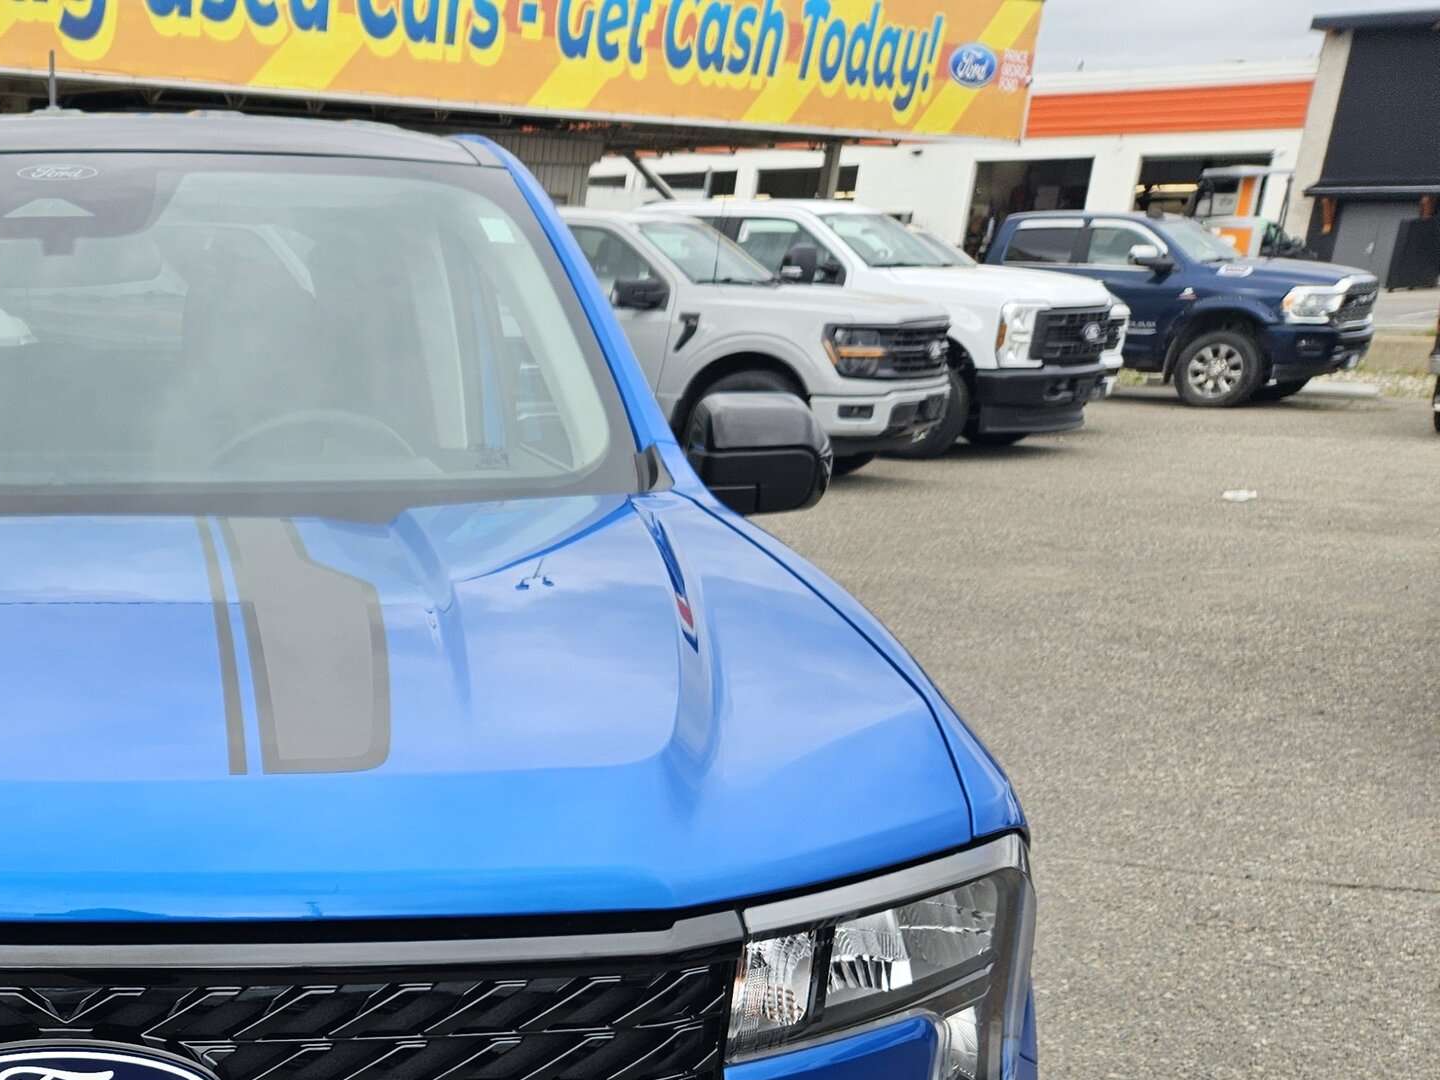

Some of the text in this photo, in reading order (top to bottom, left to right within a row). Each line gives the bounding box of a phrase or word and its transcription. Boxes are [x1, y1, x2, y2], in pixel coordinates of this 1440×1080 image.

[664, 0, 785, 77] Cash
[798, 0, 944, 112] Today!
[31, 167, 83, 178] Ford
